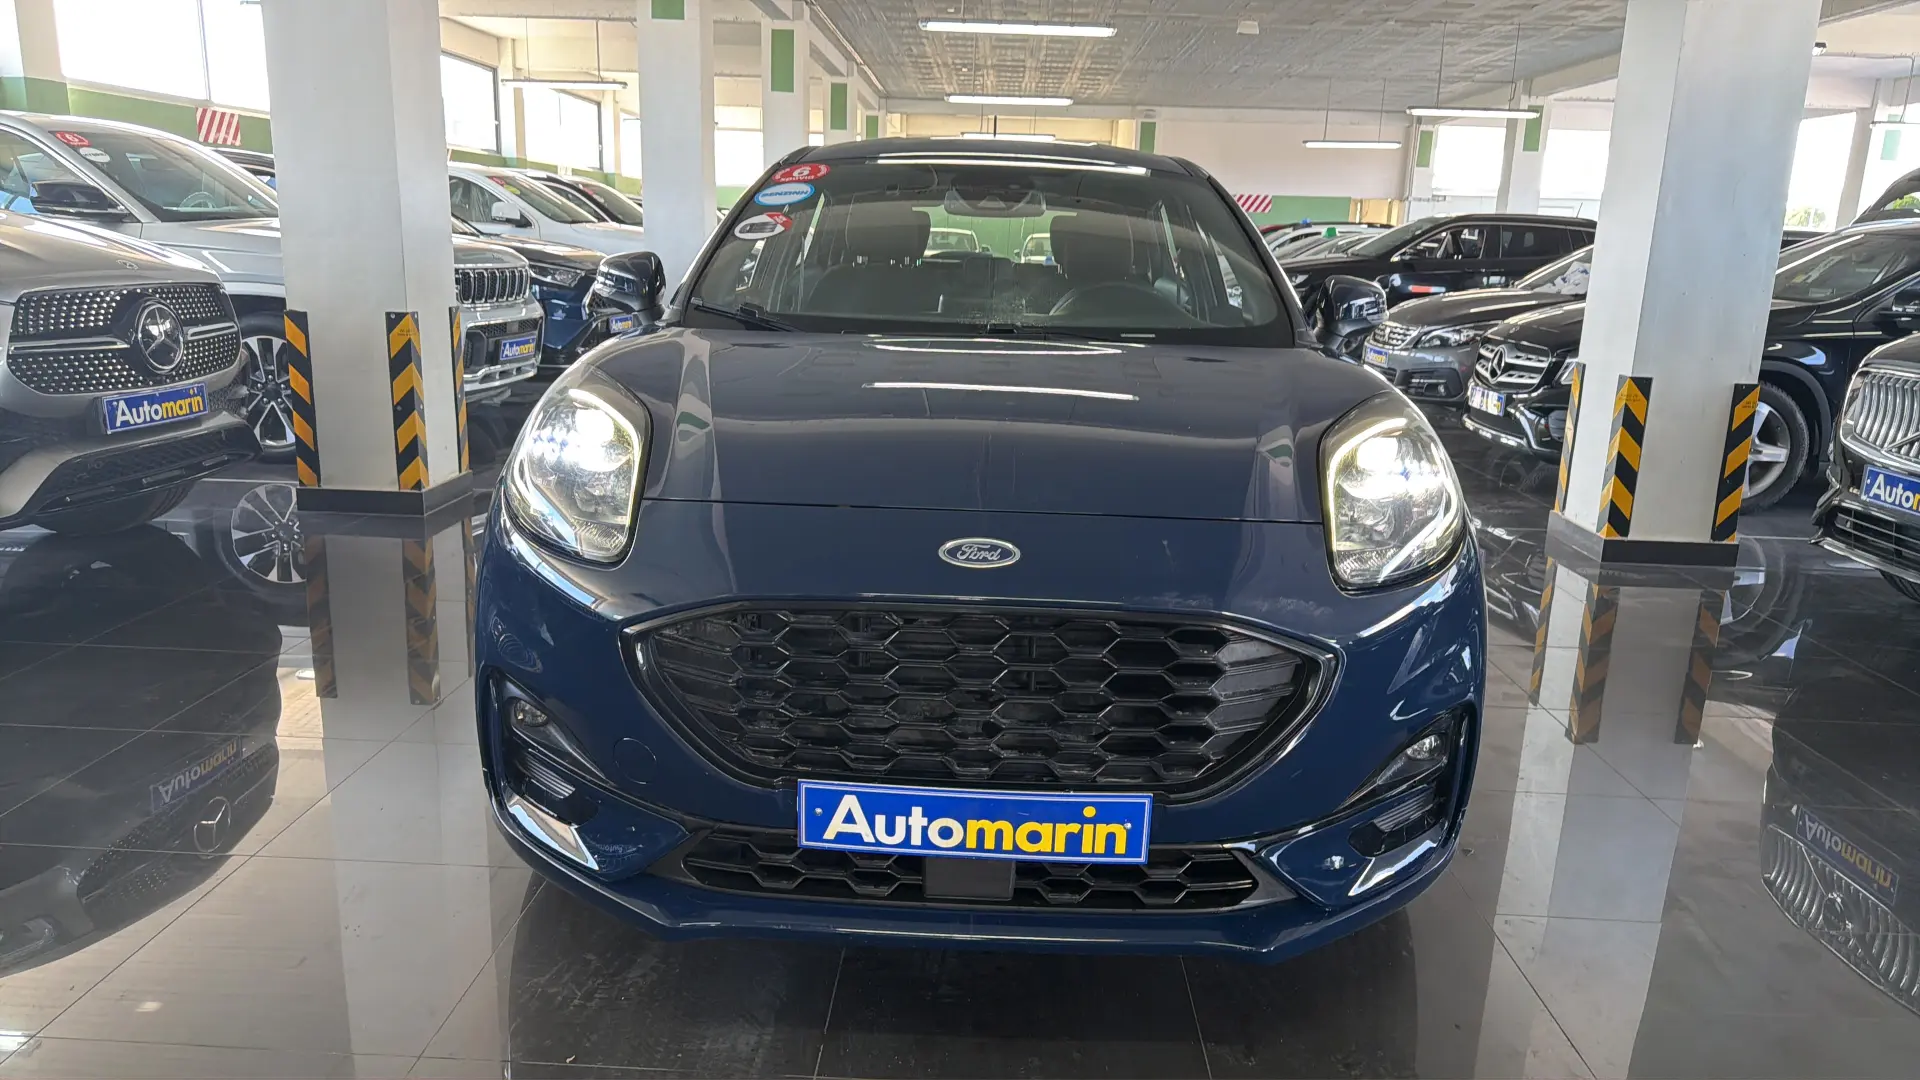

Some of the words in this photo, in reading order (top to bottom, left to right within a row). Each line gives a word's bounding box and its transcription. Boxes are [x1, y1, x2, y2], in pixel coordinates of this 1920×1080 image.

[792, 166, 812, 177] 6
[115, 387, 204, 427] Automarin
[956, 543, 1002, 560] Ford
[822, 794, 1128, 854] Automarin
